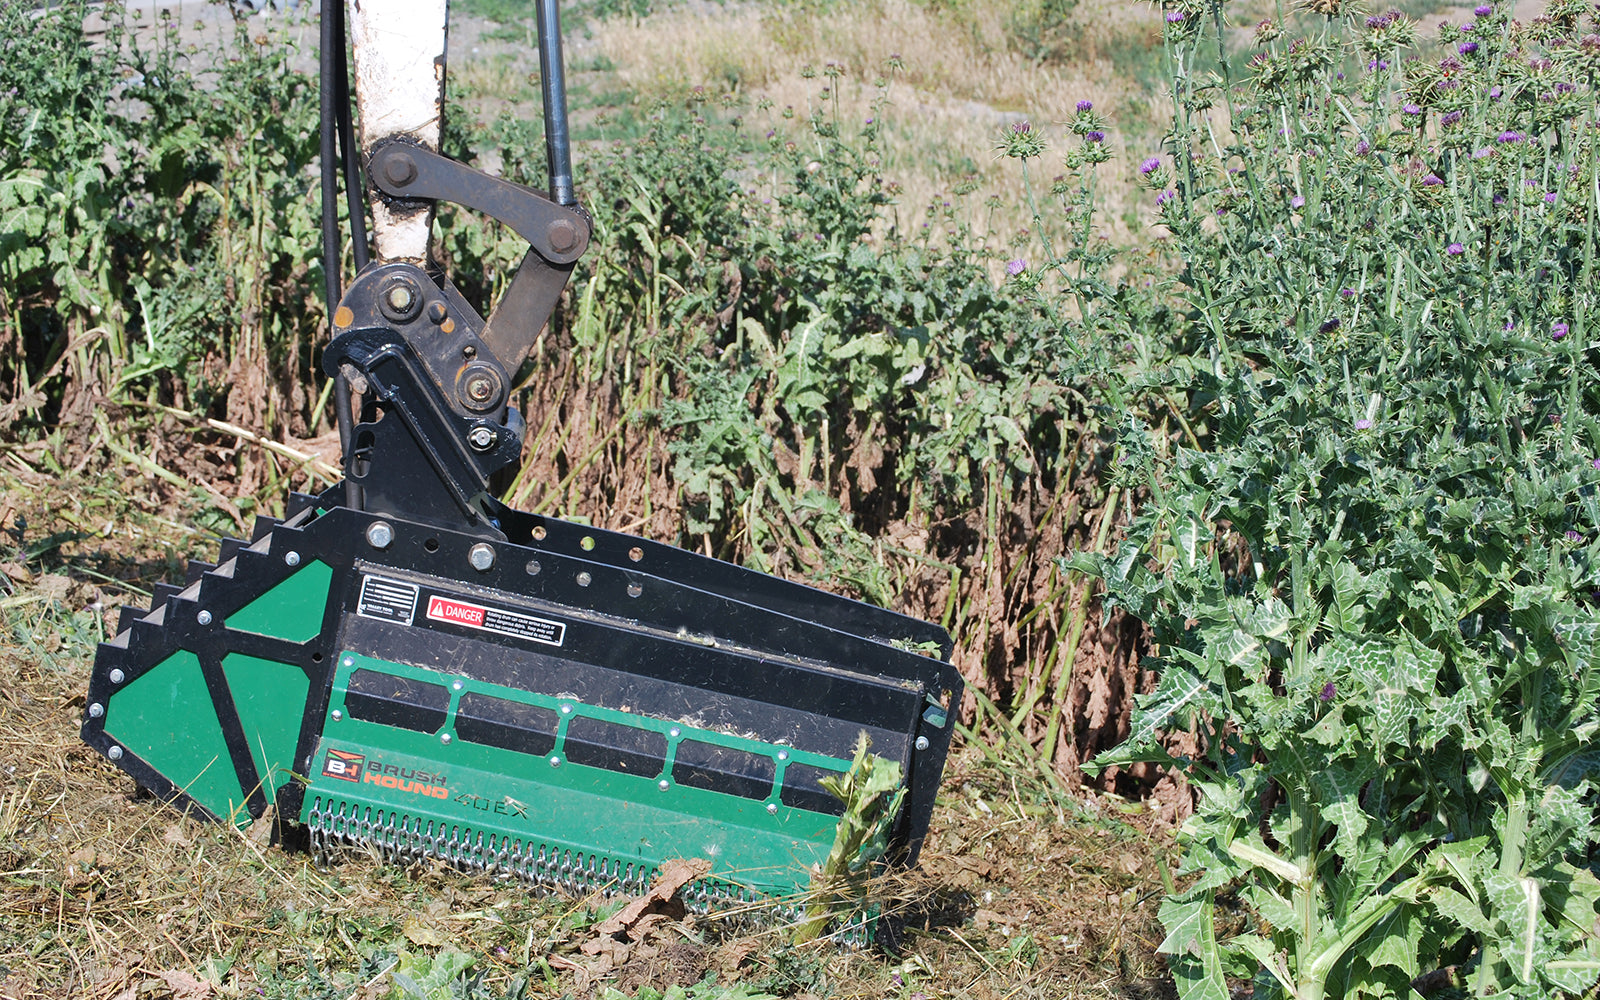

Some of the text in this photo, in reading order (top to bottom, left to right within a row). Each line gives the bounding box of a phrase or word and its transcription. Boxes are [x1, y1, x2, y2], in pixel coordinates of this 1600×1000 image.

[445, 605, 482, 623] DANGER
[364, 772, 449, 799] HOUND
[367, 760, 447, 786] BRUSH
